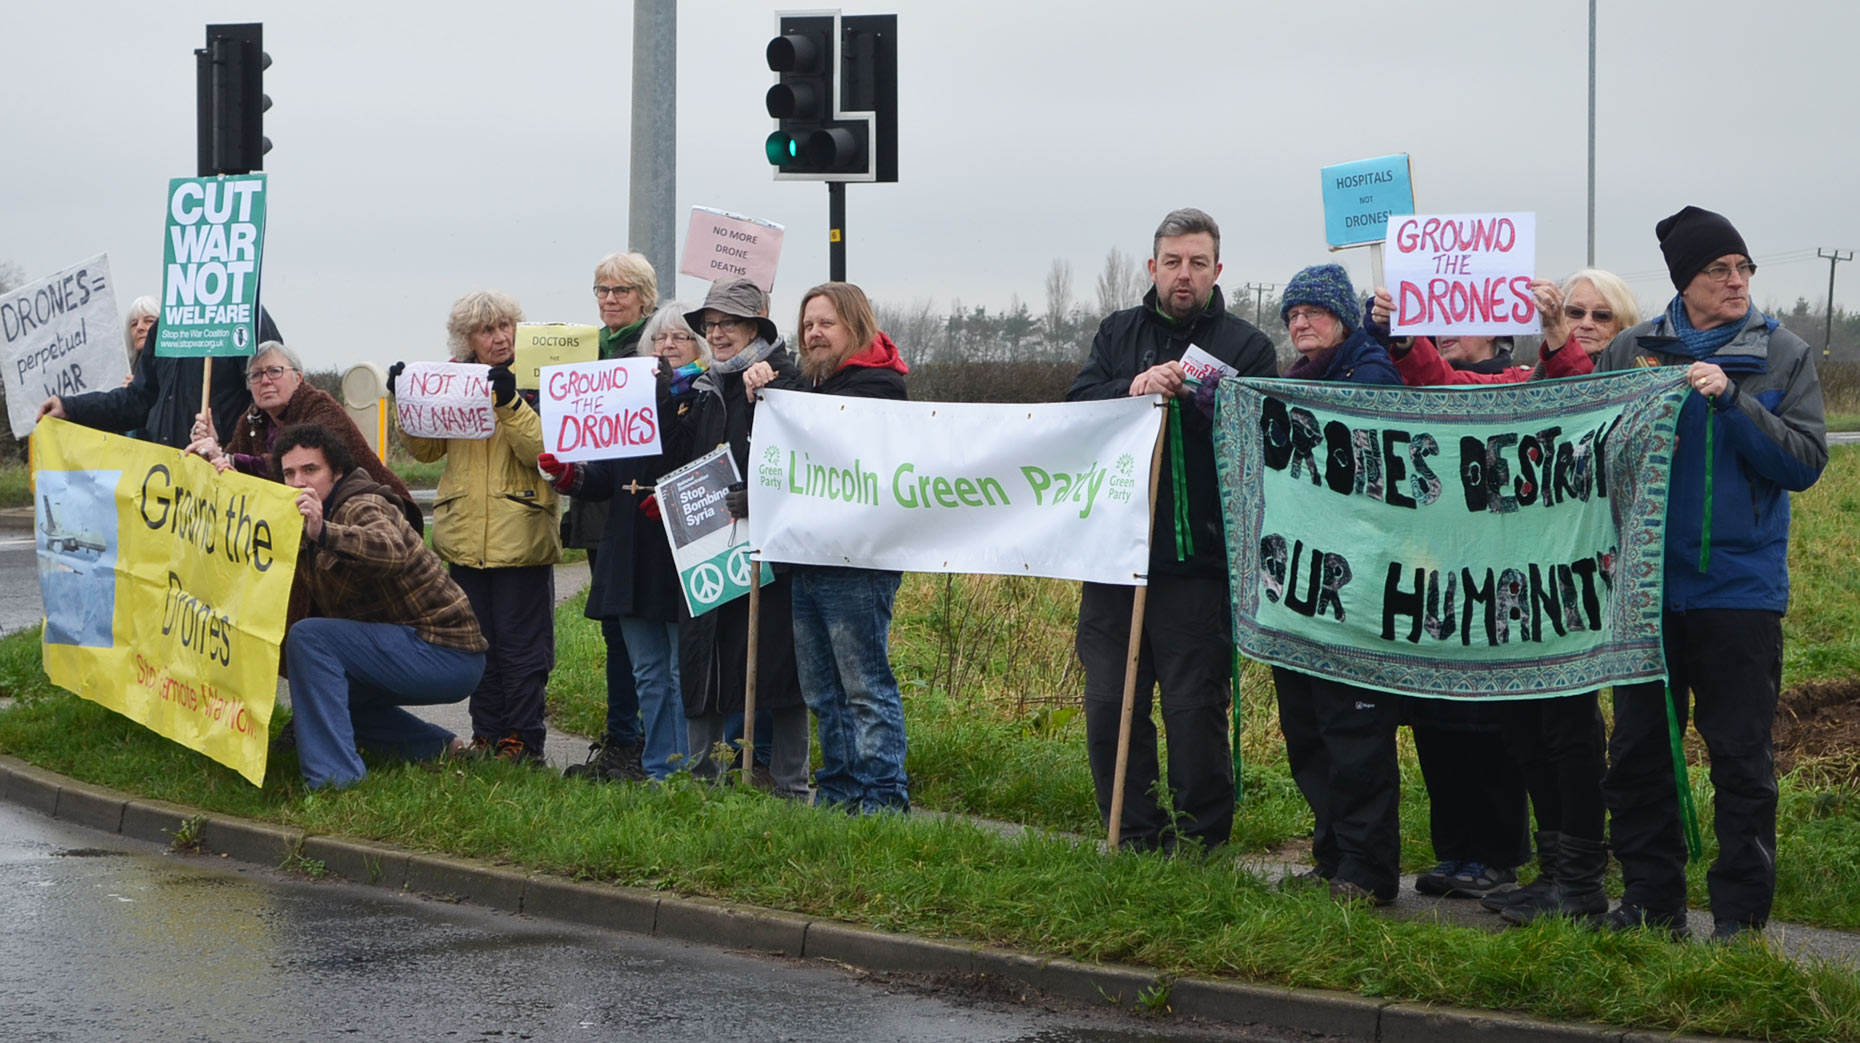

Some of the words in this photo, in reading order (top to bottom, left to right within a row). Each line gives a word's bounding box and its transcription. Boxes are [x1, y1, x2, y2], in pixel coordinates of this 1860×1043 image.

[1336, 170, 1393, 189] HOSPITALS
[171, 180, 262, 225] CUT
[1359, 195, 1374, 204] NOT
[170, 223, 257, 263] WAR
[712, 226, 728, 237] NO
[729, 231, 759, 245] MORE
[1397, 217, 1516, 253] GROUND
[715, 244, 749, 259] DRONE
[710, 260, 747, 276] DEATHS
[1432, 254, 1472, 275] THE
[166, 260, 254, 306] NOT
[1397, 276, 1535, 326] DRONES
[165, 304, 251, 325] WELFARE
[162, 329, 179, 339] Stop
[180, 330, 189, 338] the
[190, 329, 202, 338] War
[203, 328, 230, 338] Coalition
[532, 336, 580, 347] DOCTORS
[17, 318, 88, 386] perpetual
[44, 364, 88, 398] WAR
[410, 372, 459, 397] NOT
[464, 375, 489, 398] IN
[549, 366, 628, 401] GROUND
[572, 395, 604, 414] THE
[399, 403, 423, 430] MY
[431, 405, 493, 432] NAME
[557, 407, 656, 452] DRONES
[1260, 395, 1443, 509] DRONES
[1459, 414, 1622, 514] DESTROY
[759, 464, 783, 476] Green
[1109, 475, 1135, 488] Green
[760, 476, 782, 490] Party
[788, 450, 879, 506] Lincoln
[892, 462, 1011, 509] Green
[1020, 460, 1107, 519] Party
[680, 486, 706, 504] Stop
[1108, 488, 1132, 504] Party
[141, 464, 217, 555] Ground
[225, 495, 273, 572] the
[686, 507, 715, 526] Syria
[1260, 532, 1353, 623] OUR
[1380, 545, 1617, 646] HUMANITY
[162, 570, 231, 667] Drones
